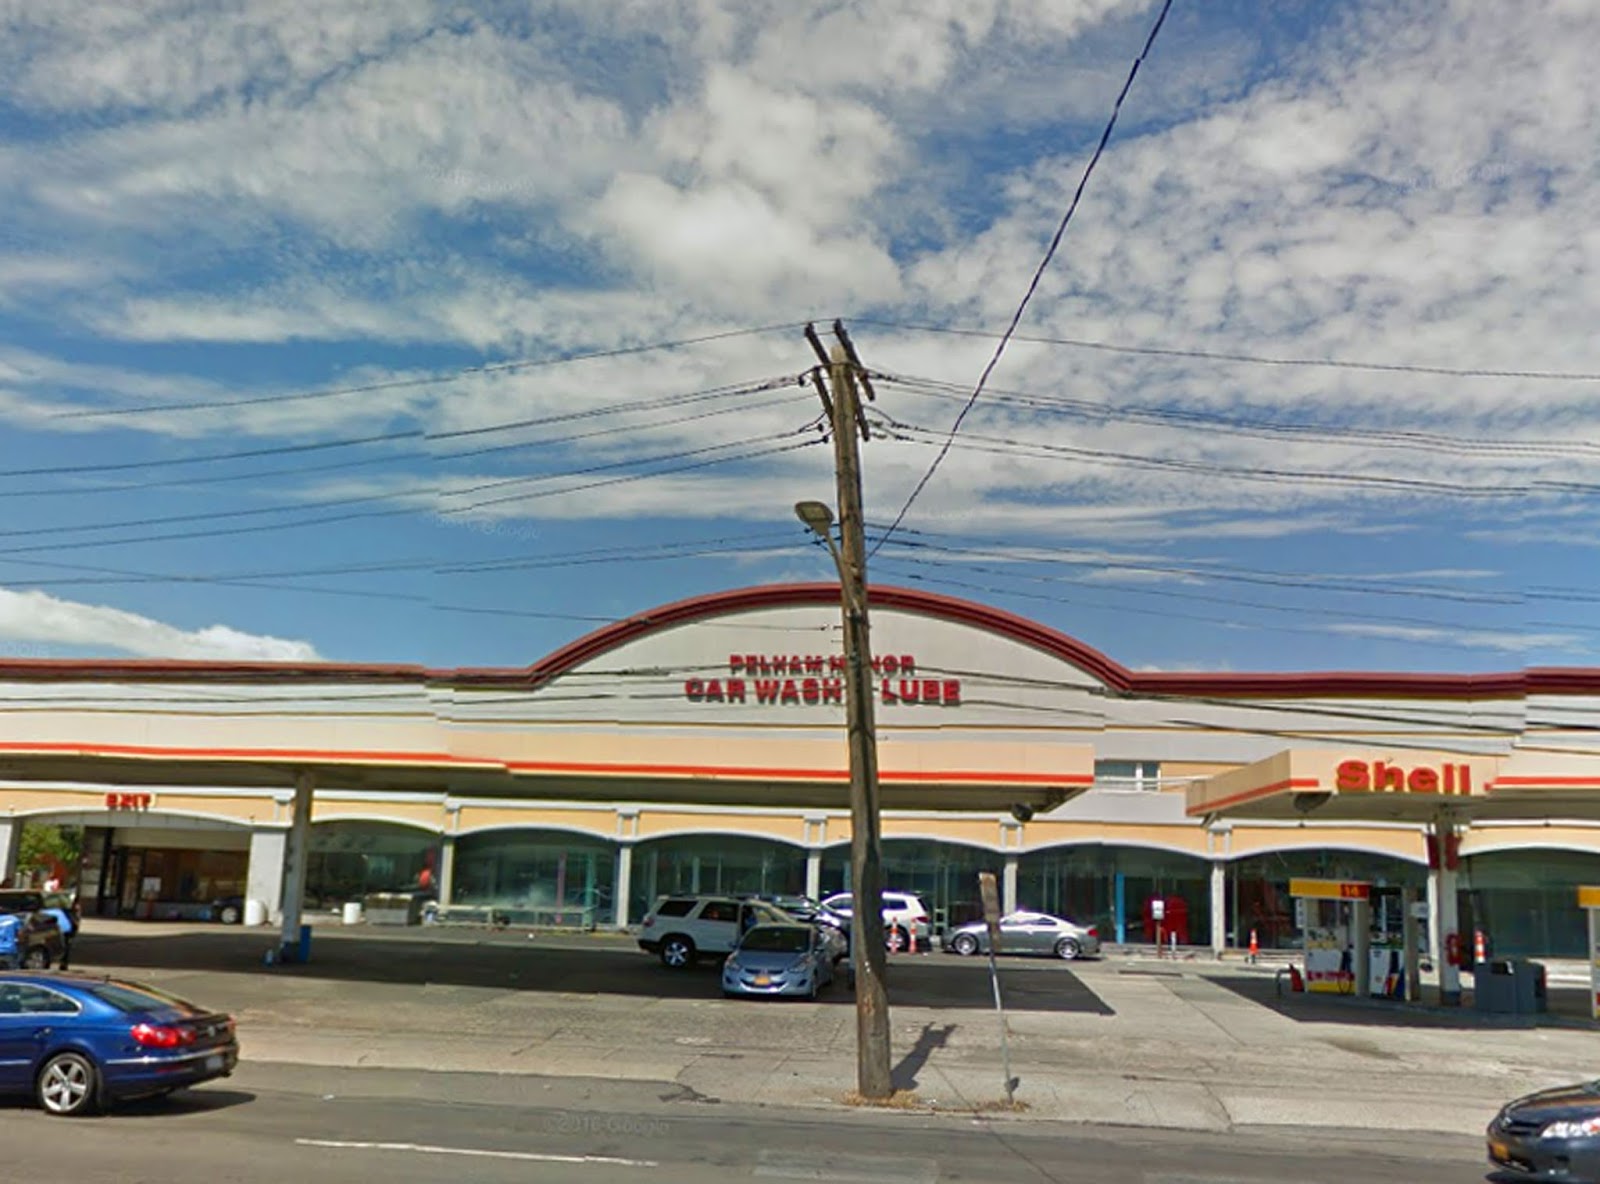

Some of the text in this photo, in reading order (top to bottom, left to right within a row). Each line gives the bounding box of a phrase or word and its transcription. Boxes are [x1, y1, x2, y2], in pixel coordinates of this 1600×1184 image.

[729, 654, 915, 677] PELHAM MNOR
[685, 678, 961, 707] CAR WASH LUBE
[1336, 759, 1472, 797] Shell
